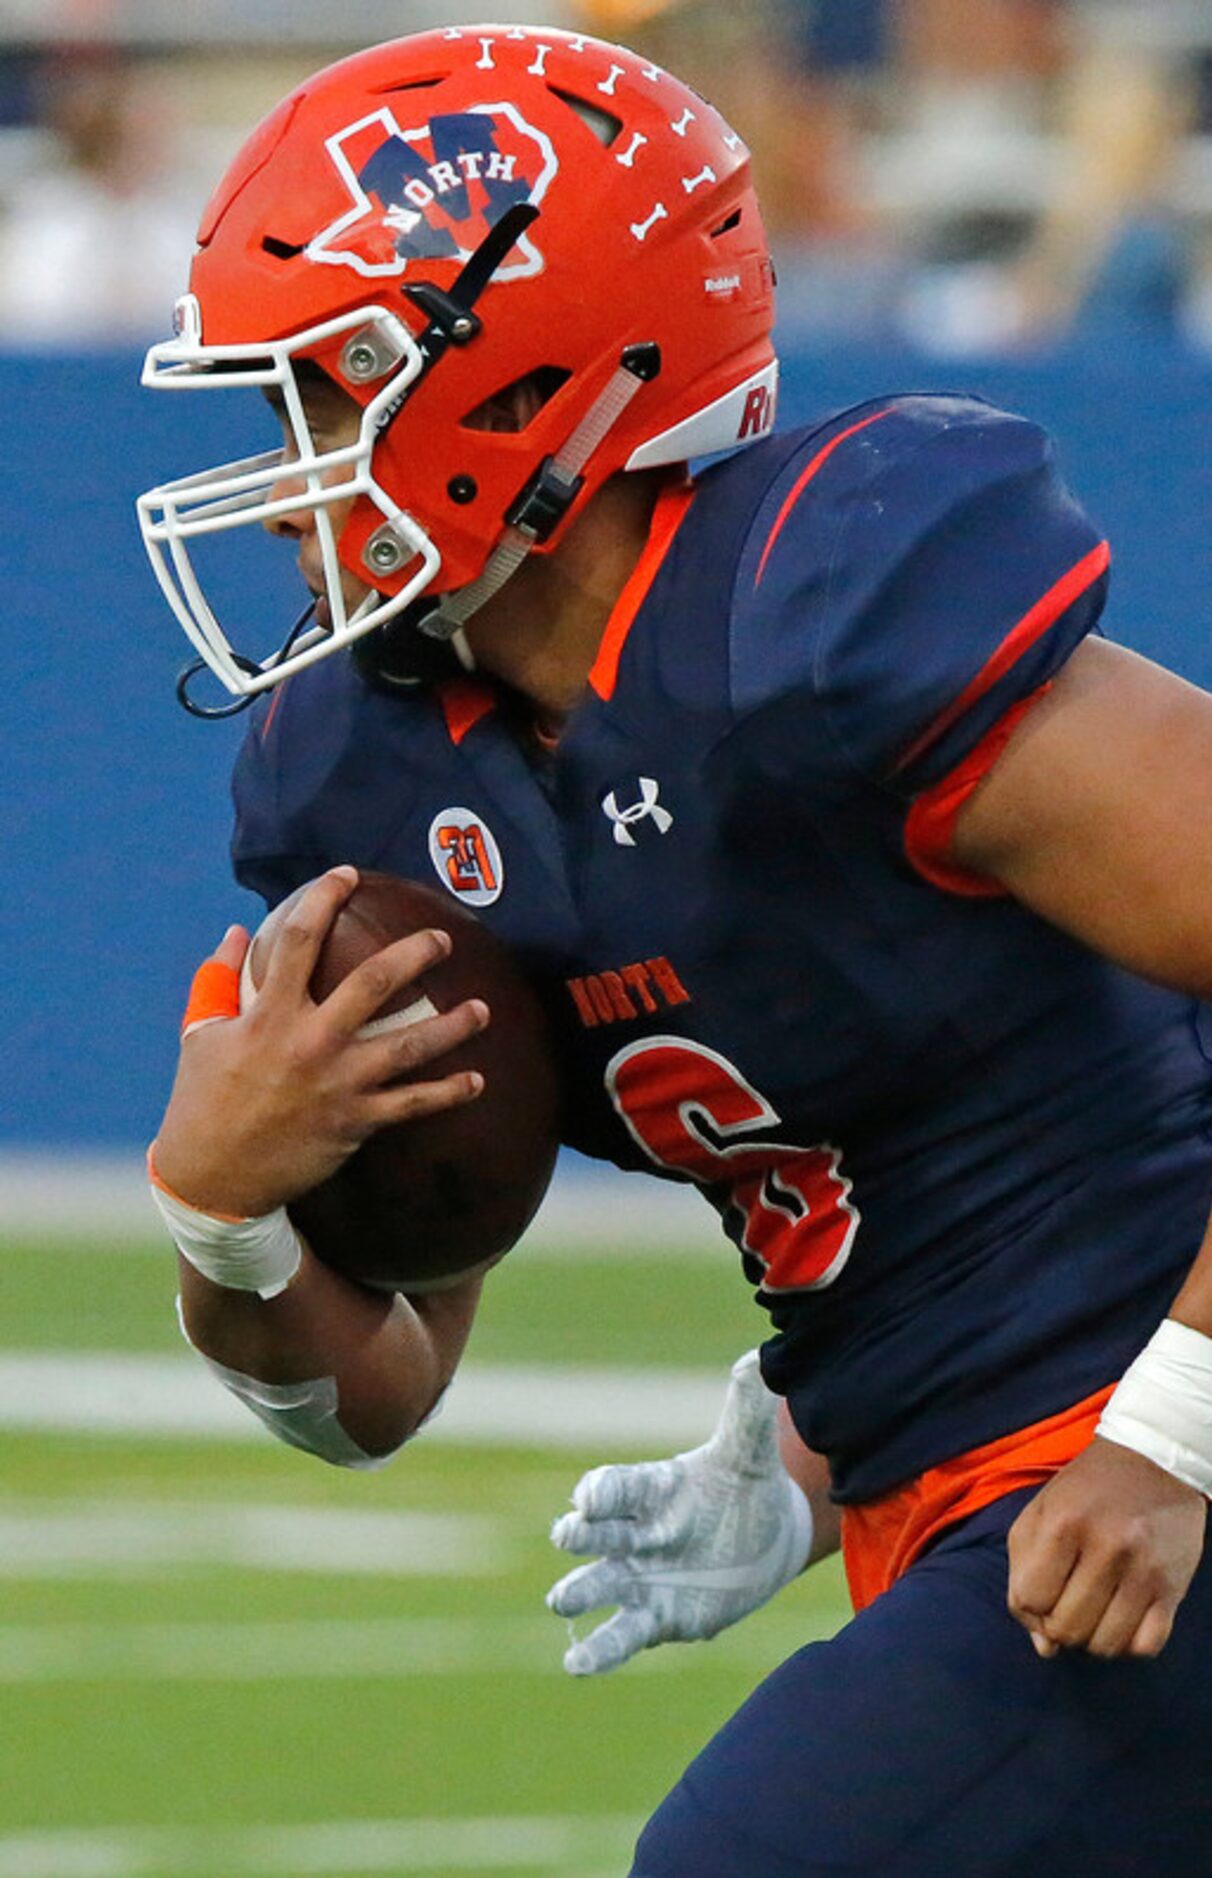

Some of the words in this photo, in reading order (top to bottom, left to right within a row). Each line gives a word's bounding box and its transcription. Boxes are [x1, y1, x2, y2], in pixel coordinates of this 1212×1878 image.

[381, 152, 517, 233] NORTH
[566, 956, 690, 1028] NORTH
[604, 1034, 862, 1295] 6
